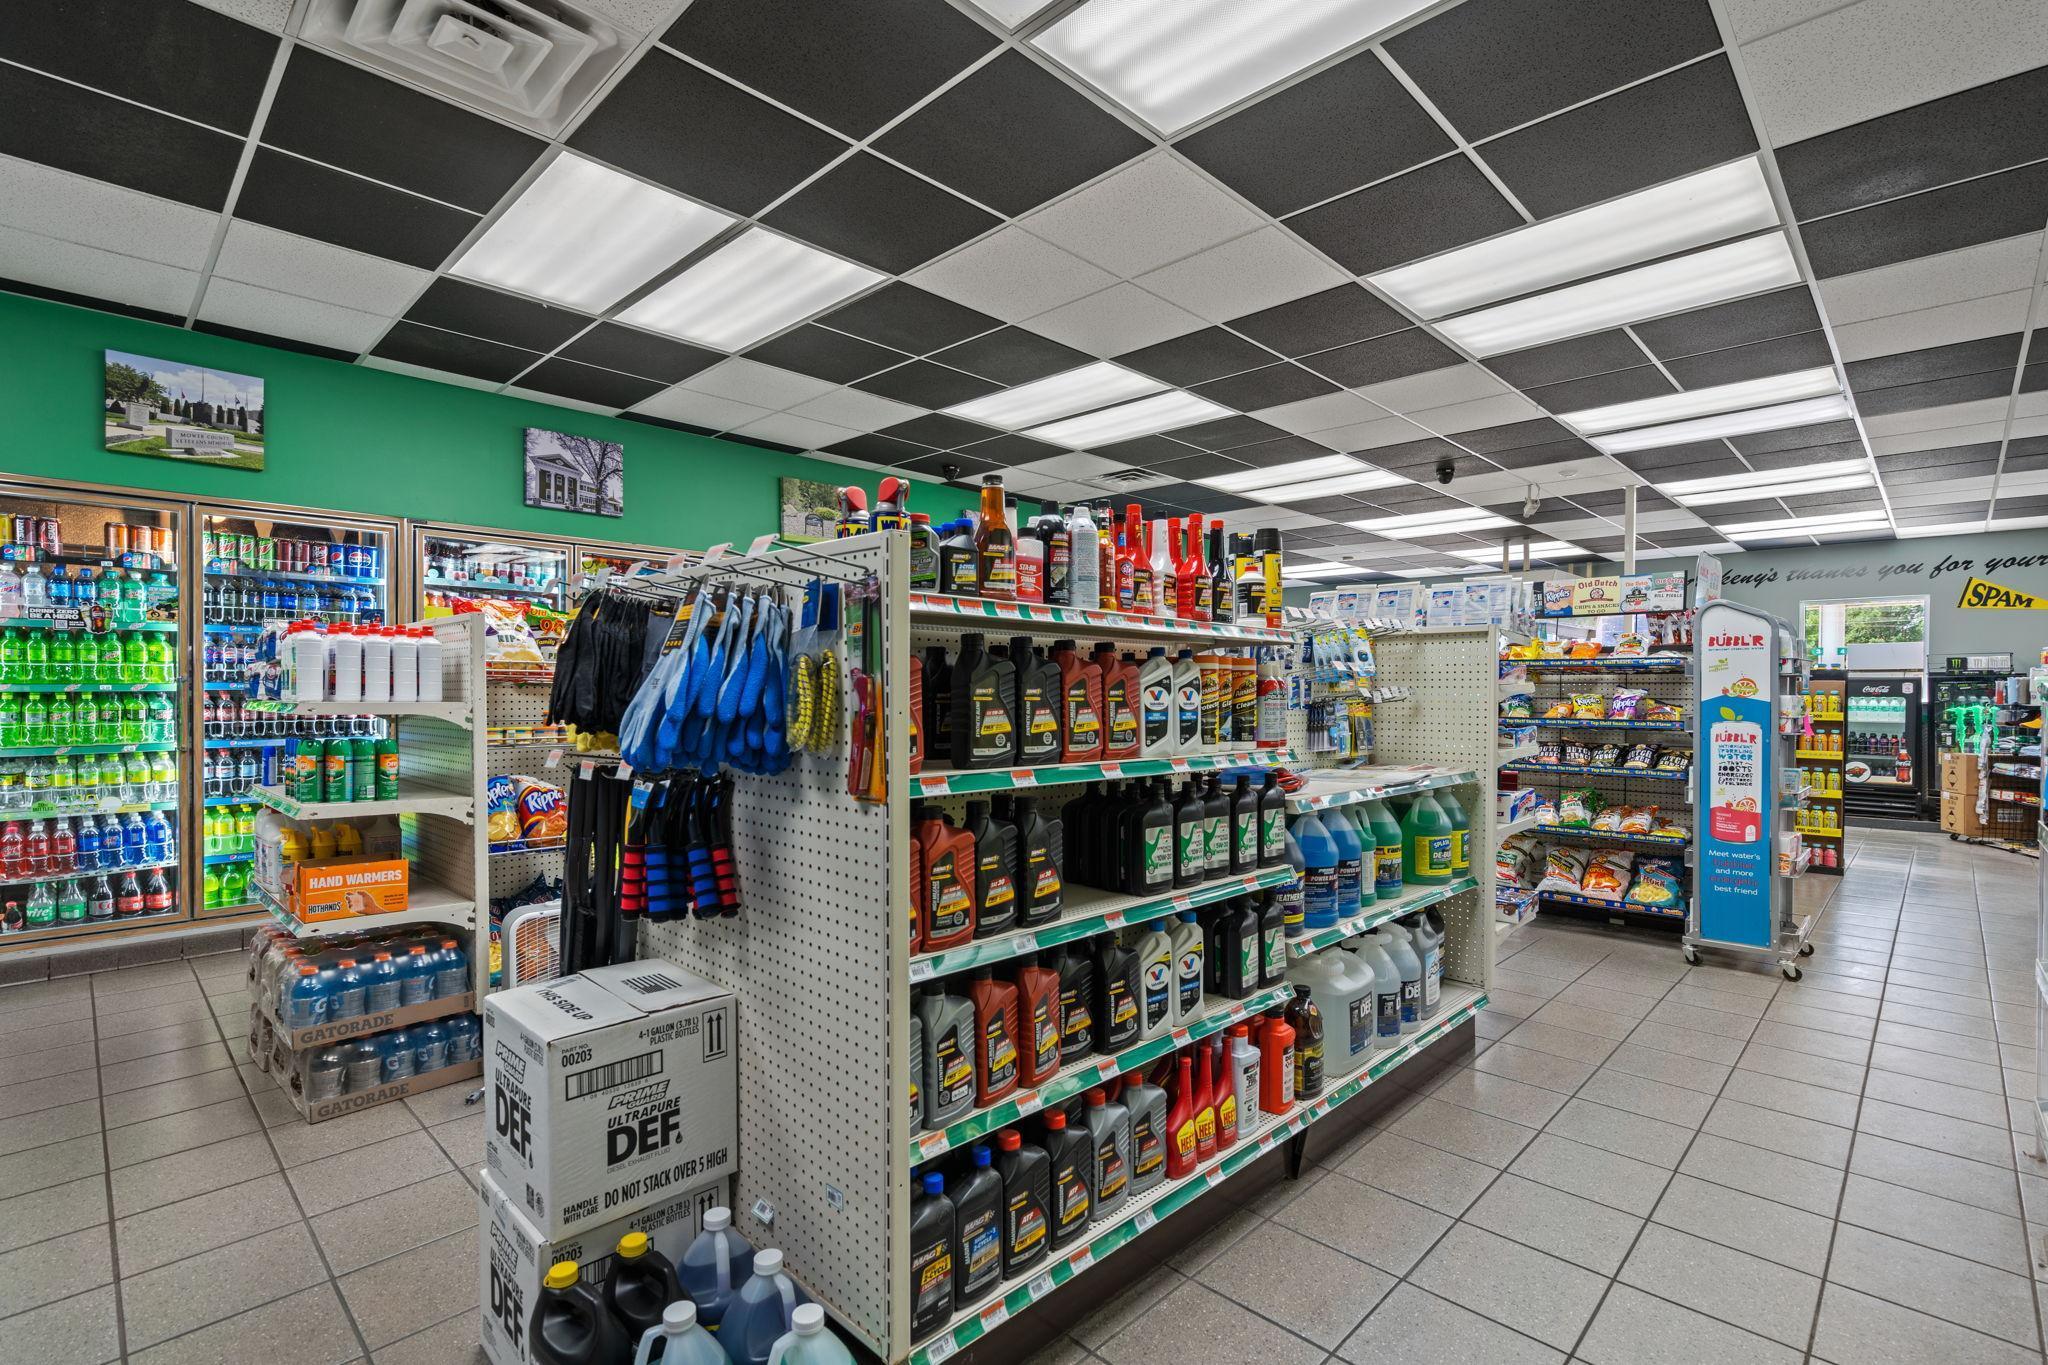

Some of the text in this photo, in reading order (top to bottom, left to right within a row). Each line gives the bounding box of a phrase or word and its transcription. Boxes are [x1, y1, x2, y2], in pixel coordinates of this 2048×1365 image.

[180, 432, 204, 440] MOWER
[1786, 566, 1868, 582] thanks
[1878, 563, 1923, 581] you
[1929, 554, 1974, 580] for
[1985, 553, 2048, 576] your
[1578, 579, 1618, 590] Old Dutch
[1546, 589, 1570, 603] Ripples
[1967, 582, 2035, 609] SPAM
[1708, 634, 1764, 647] BUBBL'R
[1862, 685, 1891, 694] Coca-Cola
[1612, 698, 1637, 710] Ripples
[1433, 850, 1452, 859] DE-BU
[1708, 850, 1761, 861] Meet water's
[309, 870, 402, 889] HAND WARMERS
[1714, 885, 1758, 896] best friend
[308, 902, 341, 915] HOTHANDS
[536, 989, 594, 1021] THIS SIDE UP
[301, 1013, 394, 1044] GATORADE
[638, 1029, 650, 1039] 4-1
[650, 1023, 675, 1037] GALLON
[650, 1025, 700, 1046] PLASTIC BOTTLES
[495, 1040, 527, 1076] PRIME
[561, 1048, 593, 1068] 00203
[495, 1067, 532, 1111] ULTRAPURE
[608, 1079, 671, 1110] PRIME
[318, 1083, 409, 1118] GATORADE
[627, 1091, 667, 1110] GUARD
[495, 1083, 532, 1162] DEF
[607, 1096, 682, 1129] ULTRAPURE
[606, 1108, 681, 1167] DEF
[1198, 1120, 1215, 1139] HEET
[1180, 1133, 1196, 1153] HEET
[606, 1147, 671, 1174] DIESEL EXHAUST FLUID
[604, 1148, 728, 1209] DO NOT STACK OVER 5 HIGH
[1068, 1186, 1079, 1198] ATF
[563, 1195, 599, 1216] HANDLE
[563, 1204, 600, 1225] WITH CARE
[641, 1210, 665, 1227] GALLON
[641, 1208, 691, 1234] PLASTIC BOTTLES
[1022, 1212, 1034, 1225] ATF
[924, 1262, 950, 1283] 2-CYCLE
[490, 1261, 523, 1350] DEF
